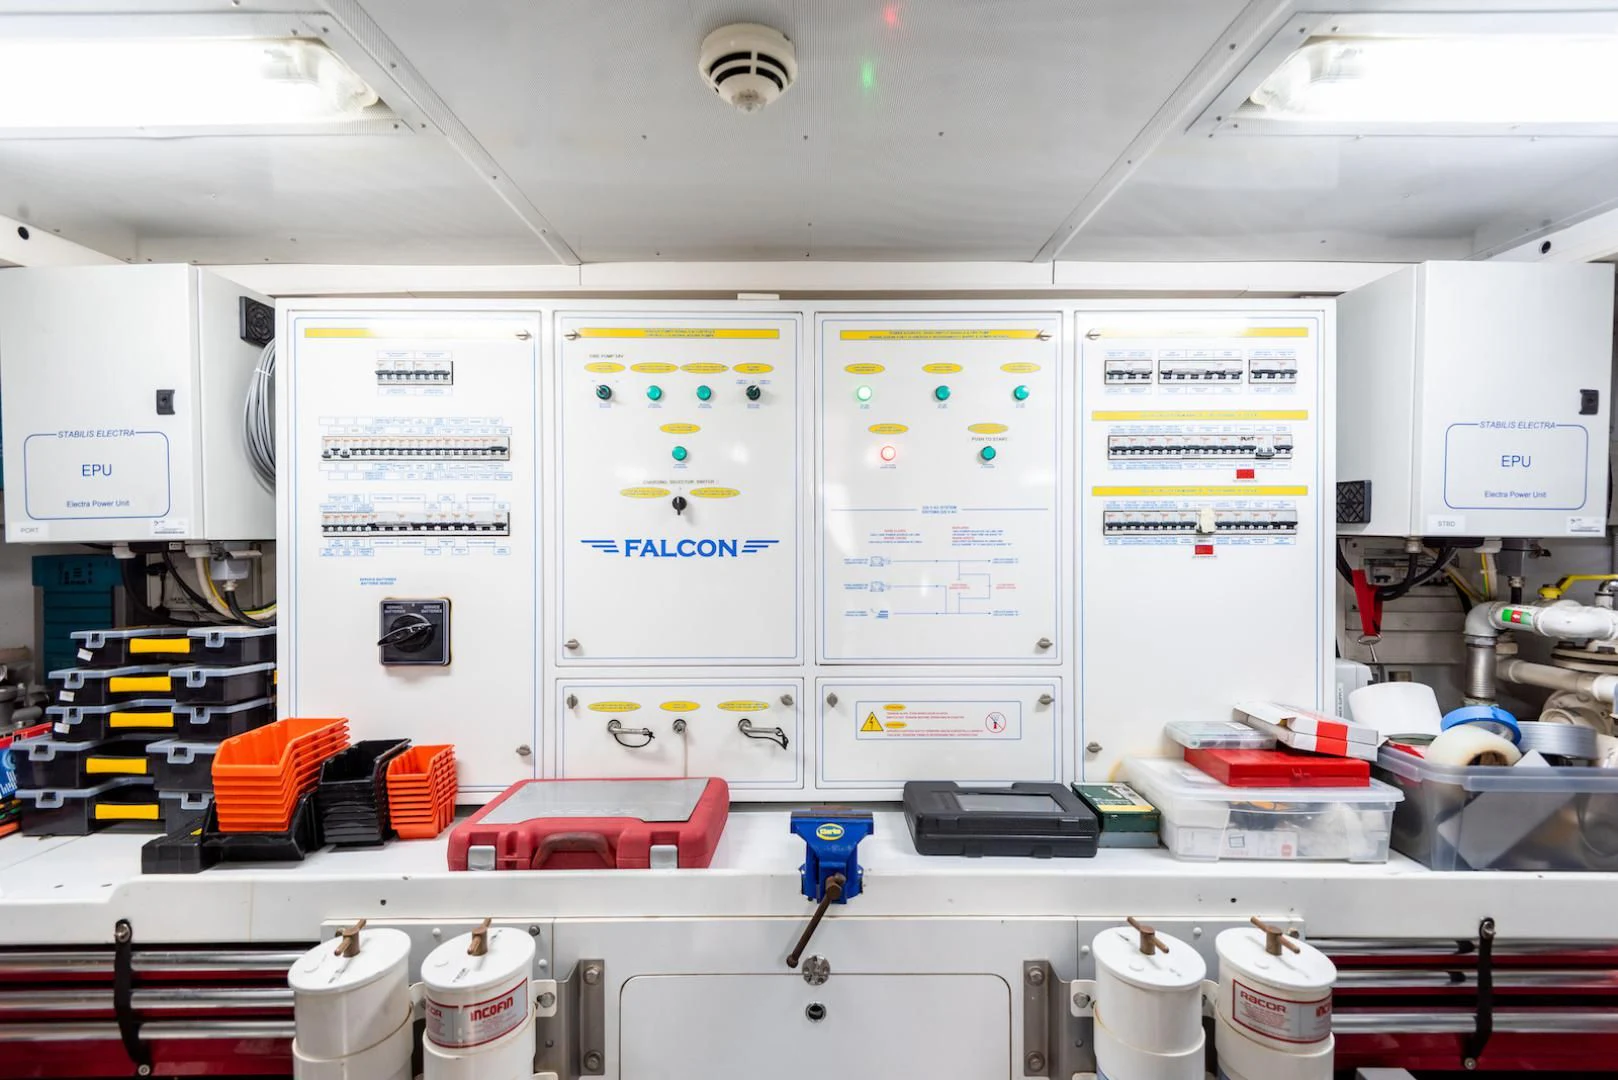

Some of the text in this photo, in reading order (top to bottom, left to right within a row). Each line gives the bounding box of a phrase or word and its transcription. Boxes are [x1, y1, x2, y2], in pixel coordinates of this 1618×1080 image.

[1479, 420, 1557, 430] STABILIS ELECTRA
[57, 428, 136, 439] STABILIS ELECTRA
[1501, 455, 1532, 468] EPU
[81, 463, 113, 478] EPU
[1484, 491, 1547, 499] Electra Power Unit
[66, 499, 130, 508] Electra Power Unit
[20, 526, 40, 534] PORT
[624, 538, 738, 558] FALCON
[471, 997, 513, 1021] INCOFIN
